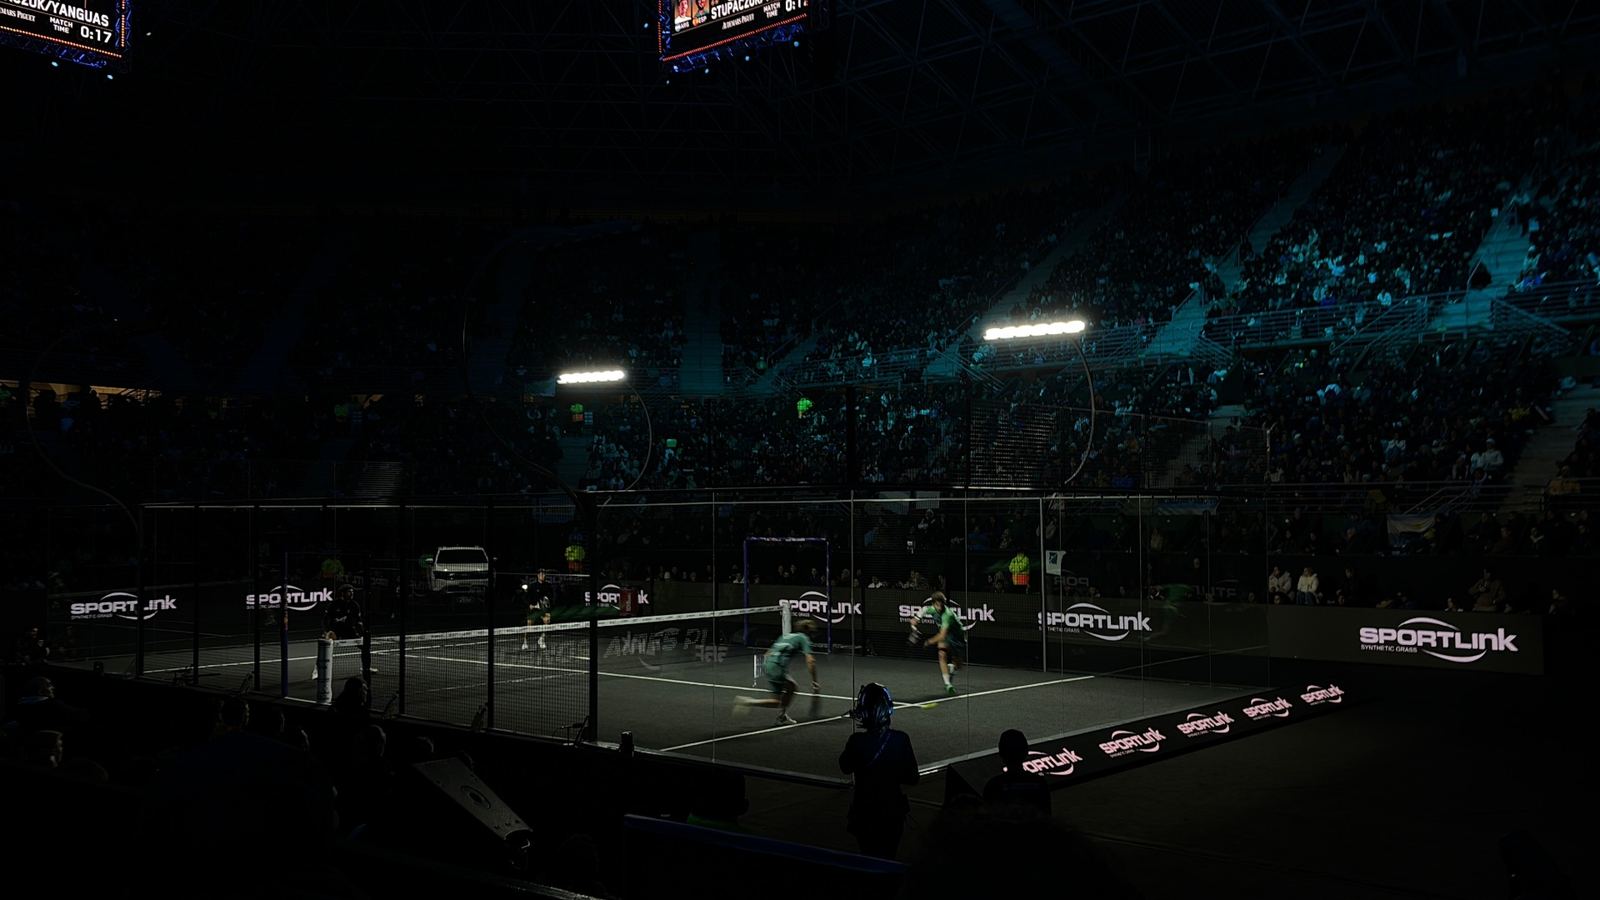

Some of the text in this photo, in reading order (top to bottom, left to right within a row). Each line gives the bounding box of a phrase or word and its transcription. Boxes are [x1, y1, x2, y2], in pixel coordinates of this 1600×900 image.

[49, 17, 73, 28] MATCH
[53, 24, 70, 34] TIME
[80, 26, 112, 43] 0:17
[1360, 644, 1394, 652] SYNTHETIC
